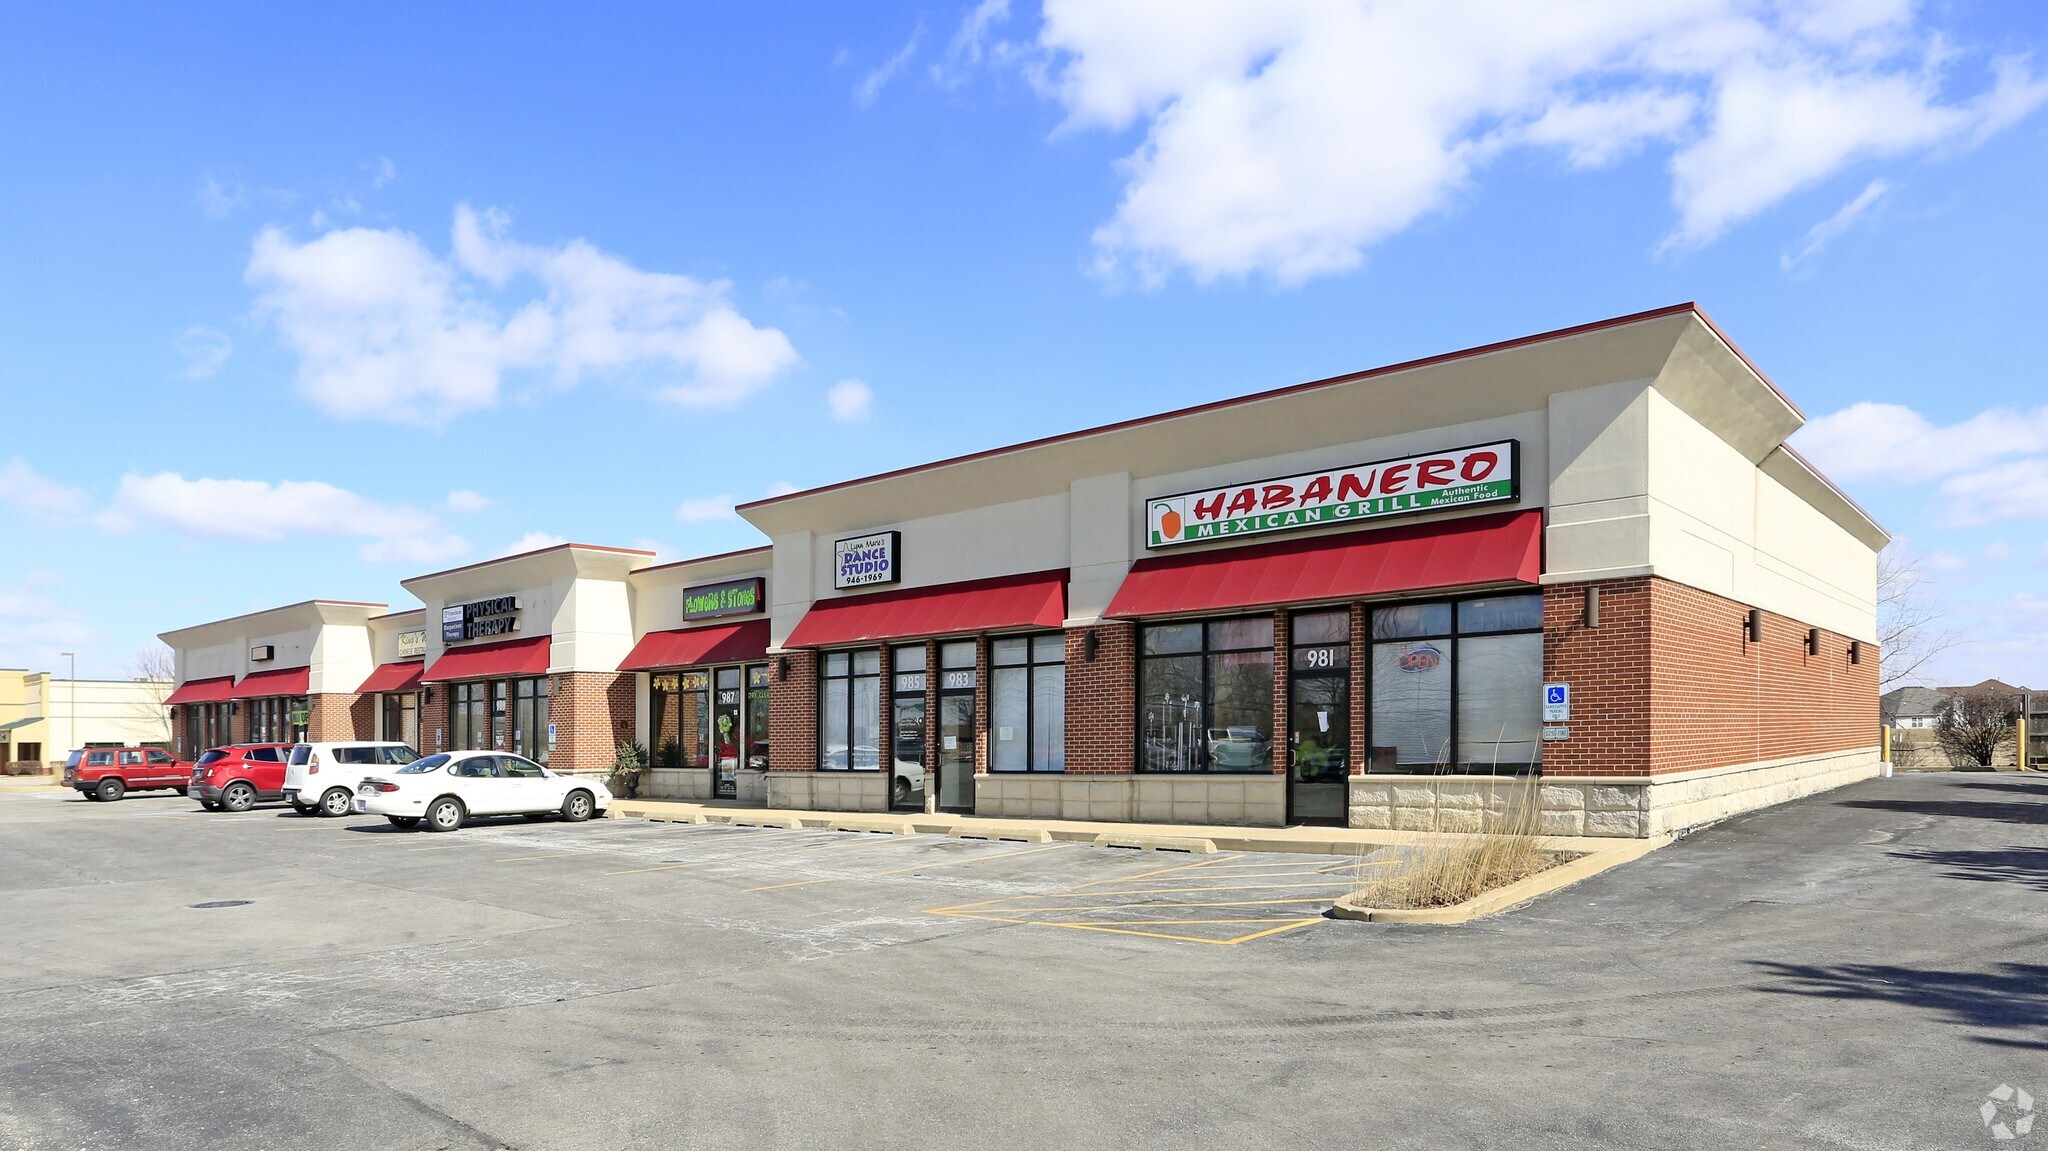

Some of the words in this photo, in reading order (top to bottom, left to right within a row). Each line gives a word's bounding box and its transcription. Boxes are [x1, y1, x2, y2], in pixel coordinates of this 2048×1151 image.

[1193, 451, 1498, 520] HABANERO
[1442, 484, 1489, 497] Authentic
[1431, 493, 1470, 506] Mexican
[1474, 489, 1498, 500] Food
[1197, 508, 1321, 537] MEXICAN
[1334, 495, 1421, 518] GRILL
[844, 547, 886, 564] DANCE
[841, 559, 889, 577] STUDIO
[846, 572, 883, 584] 946-1969
[466, 597, 515, 619] PHYSICAL
[466, 619, 512, 639] THERAPY
[1307, 650, 1334, 667] 981
[1399, 653, 1438, 669] OPEN
[901, 675, 920, 689] 985
[950, 672, 969, 687] 983
[722, 692, 735, 703] 987
